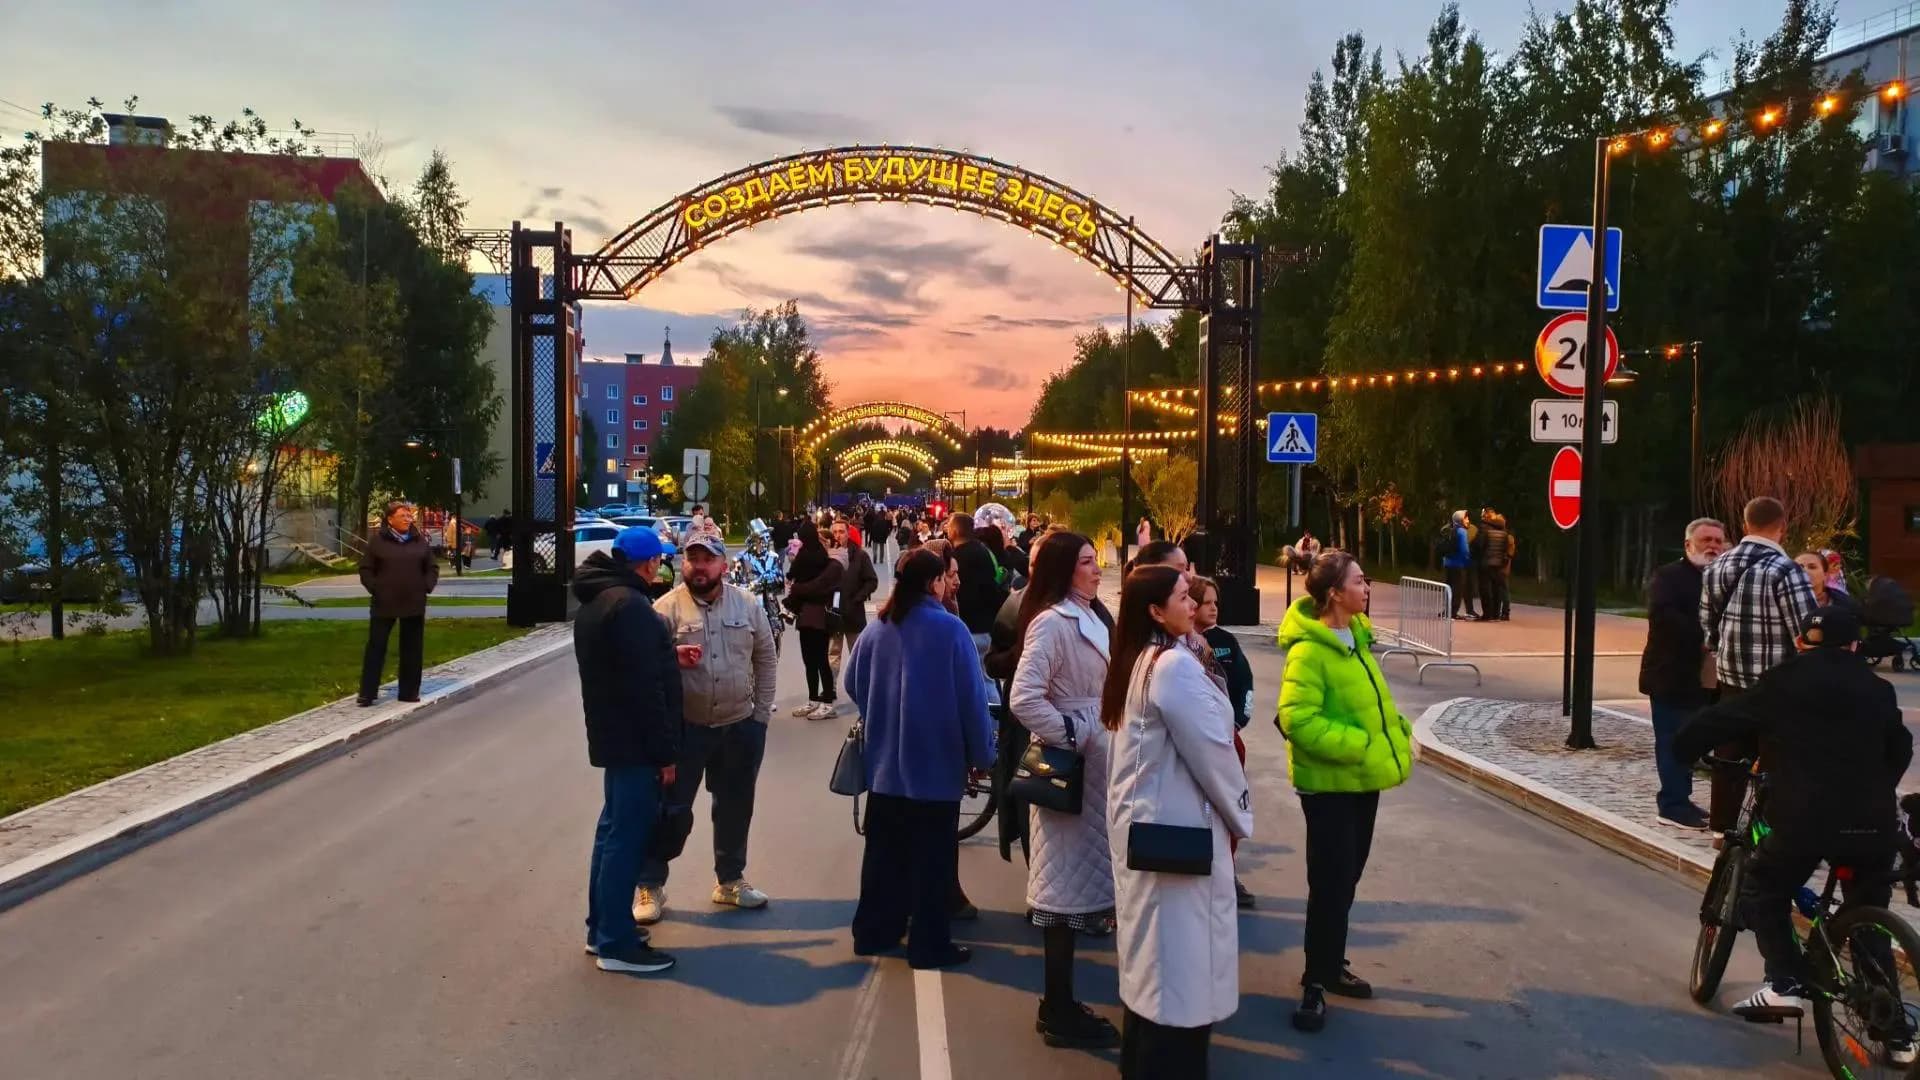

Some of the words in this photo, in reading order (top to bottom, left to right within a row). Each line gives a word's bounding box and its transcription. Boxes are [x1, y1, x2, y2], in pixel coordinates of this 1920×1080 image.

[684, 160, 835, 230] СОЗДАЁМ
[843, 157, 998, 195] БУДУЩЕЕ
[1002, 178, 1096, 240] ЗДЕСЬ
[830, 414, 846, 427] МЫ
[888, 405, 906, 416] МЫ
[907, 409, 942, 428] ВМЕСТЕ
